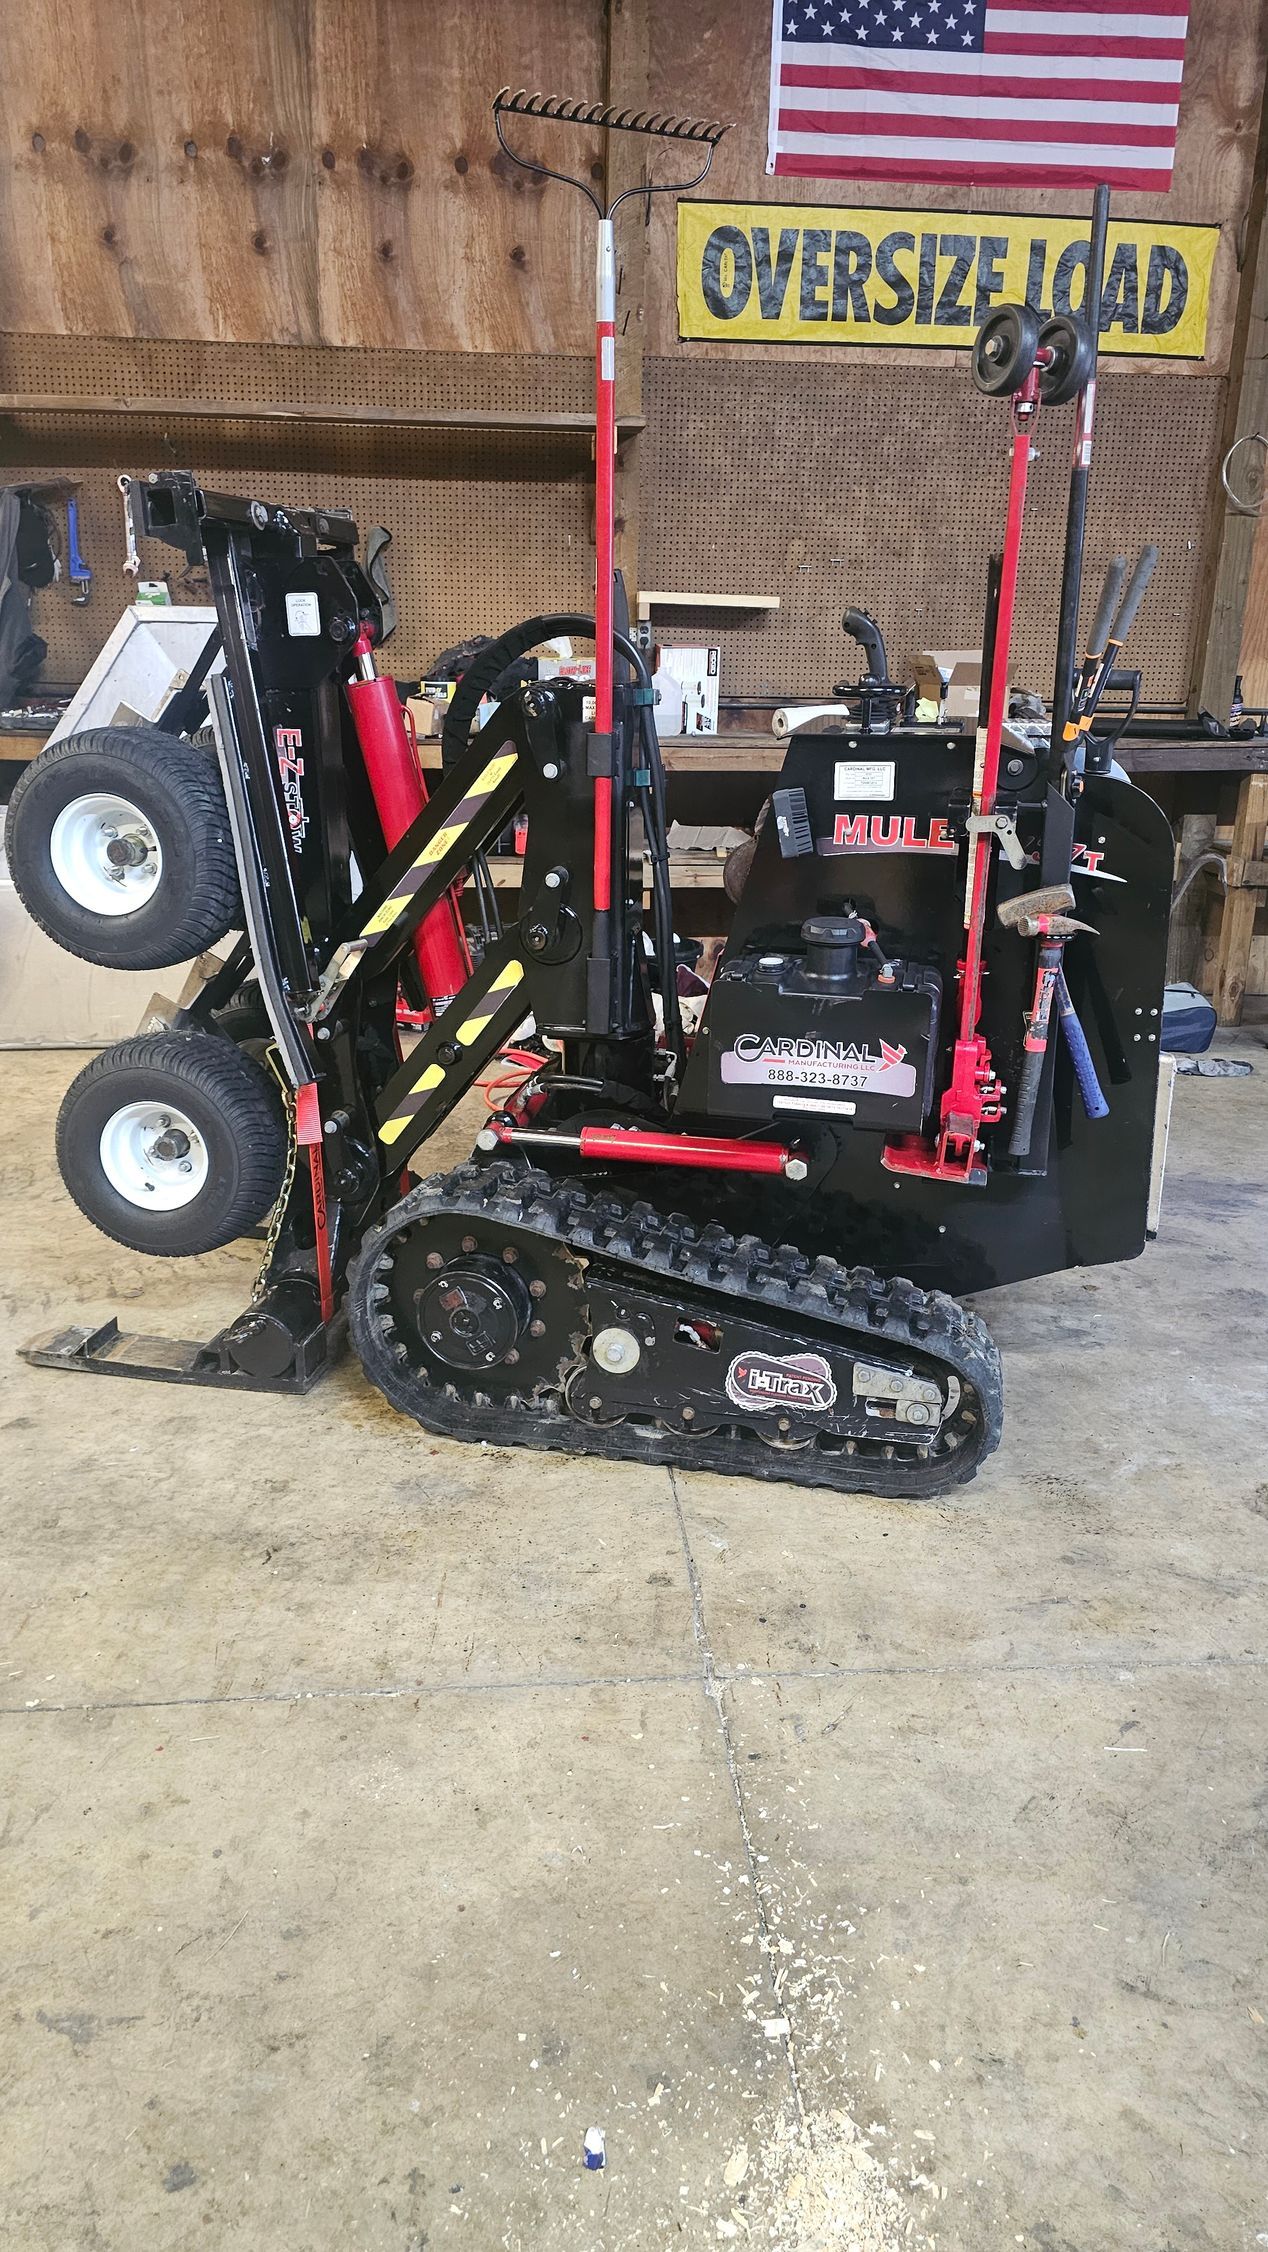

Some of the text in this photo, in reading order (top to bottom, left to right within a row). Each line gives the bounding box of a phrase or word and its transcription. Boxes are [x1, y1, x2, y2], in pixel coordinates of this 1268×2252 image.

[701, 225, 1189, 335] OVERSIZE LOAD
[428, 832, 448, 856] DANGER
[833, 814, 955, 849] MULE
[734, 1033, 877, 1063] CARDINAL
[768, 1069, 868, 1088] 888-323-8737
[788, 1059, 875, 1072] MANUFACTURING LLC
[748, 1368, 825, 1405] i-Trax
